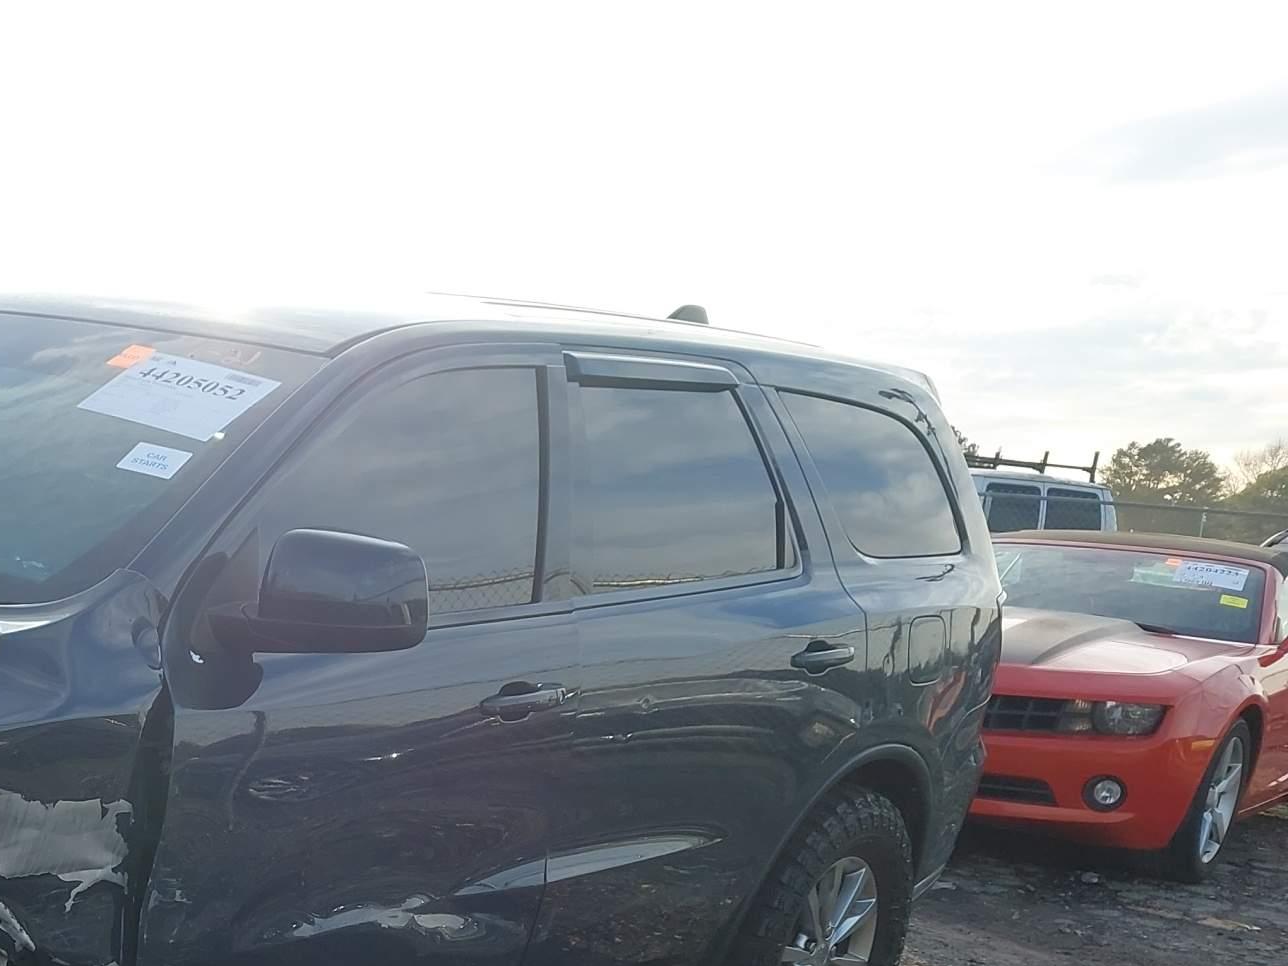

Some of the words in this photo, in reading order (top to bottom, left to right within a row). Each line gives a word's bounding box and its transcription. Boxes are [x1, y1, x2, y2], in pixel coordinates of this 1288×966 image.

[138, 366, 247, 401] 44205052
[130, 457, 170, 471] STARTS
[145, 452, 168, 462] CAR
